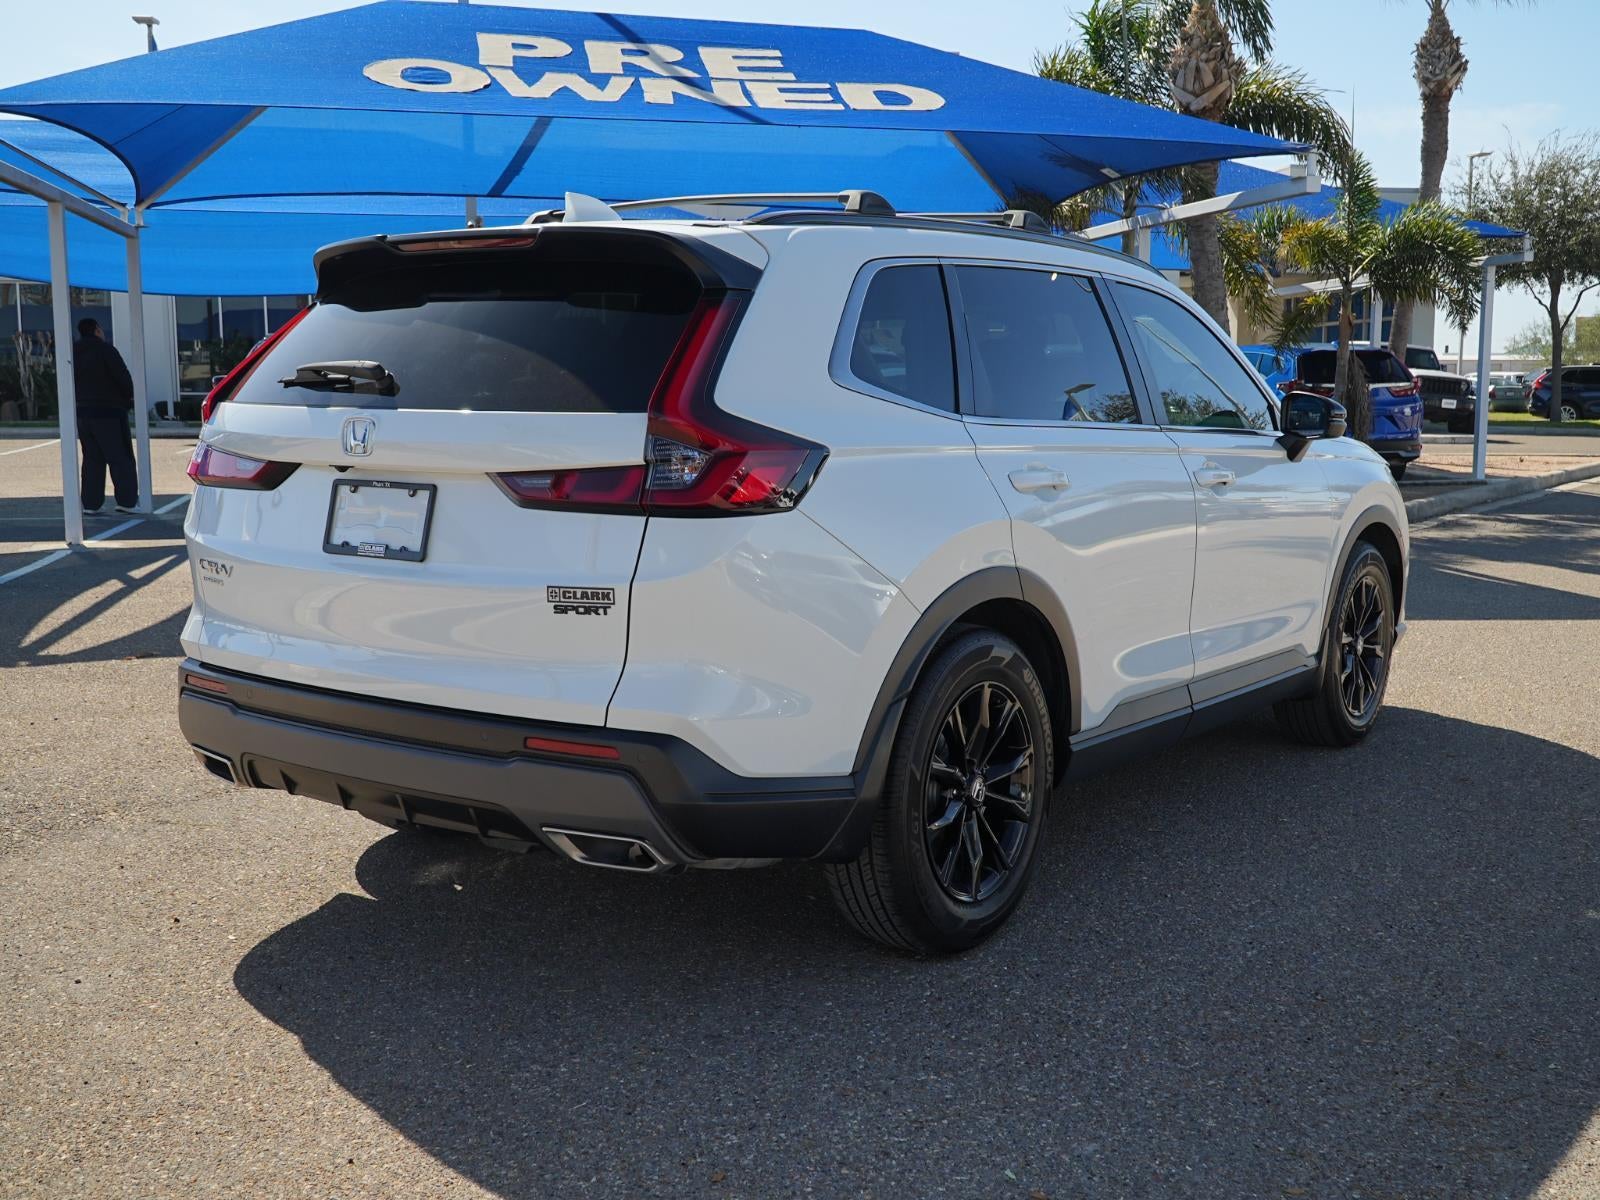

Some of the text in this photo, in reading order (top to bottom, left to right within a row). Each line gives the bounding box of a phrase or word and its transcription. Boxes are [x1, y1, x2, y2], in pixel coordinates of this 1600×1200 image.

[476, 32, 797, 81] PRE
[362, 58, 946, 111] OWNED
[553, 604, 612, 616] SPORT
[562, 590, 612, 601] CLARK
